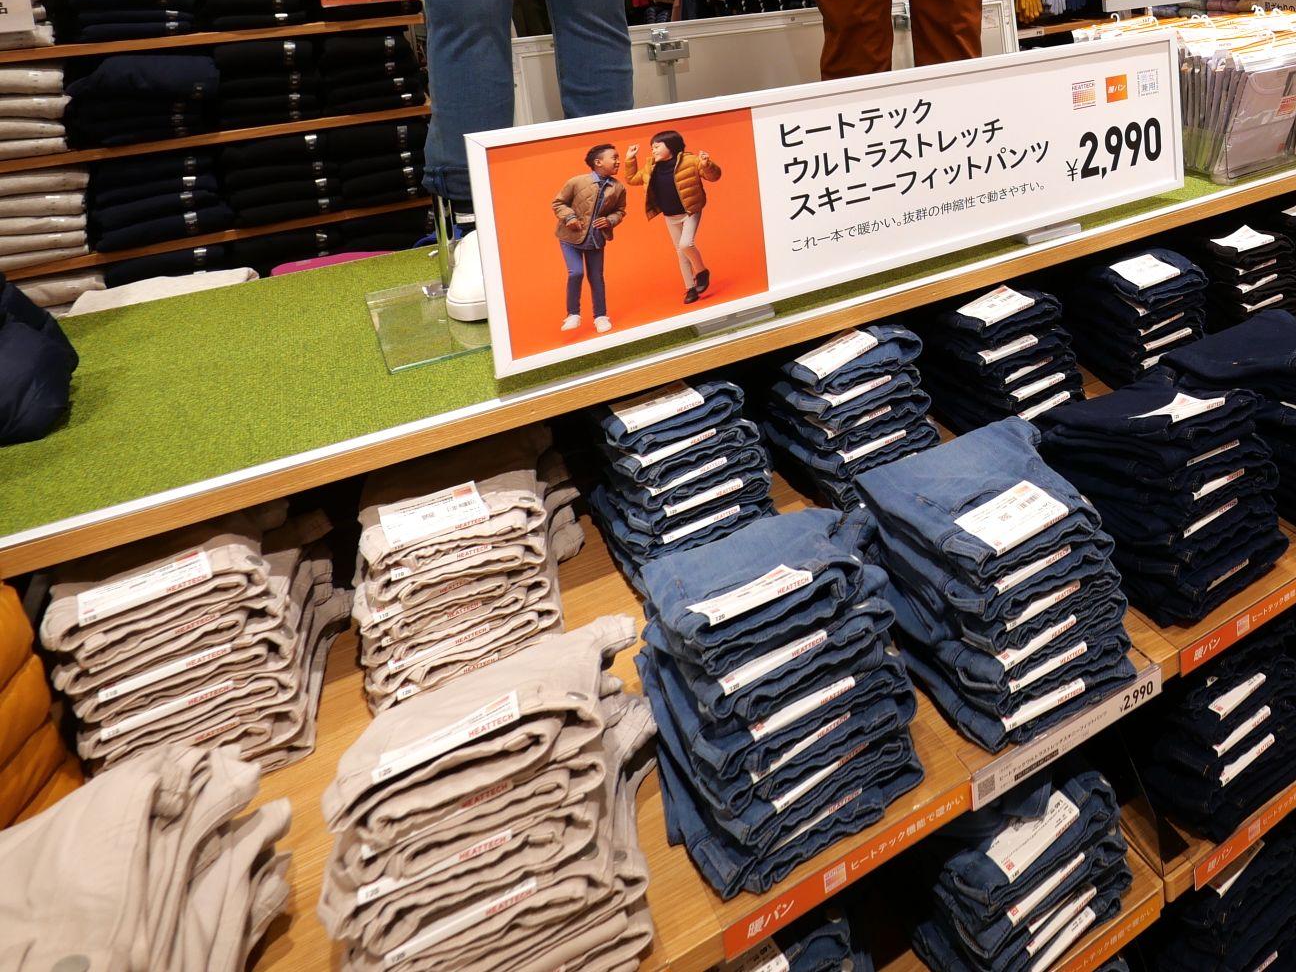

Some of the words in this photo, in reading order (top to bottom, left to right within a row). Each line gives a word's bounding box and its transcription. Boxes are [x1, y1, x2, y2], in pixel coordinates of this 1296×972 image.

[779, 98, 933, 149] ヒートテック
[783, 118, 1004, 185] ウルトラストレッチ
[1065, 117, 1162, 183] ¥2,990
[789, 140, 1050, 221] スキニーフィットパンツ
[791, 181, 1045, 252] これ一本で暖かい。抜群の伸縮性で動きやすい。
[856, 342, 876, 356] HEATTECH
[676, 400, 702, 413] HEATTECH
[699, 460, 725, 473] HEATTECH
[715, 483, 741, 497] HEATTECH
[454, 516, 487, 530] HEATTECH
[713, 508, 738, 521] HEATTECH
[456, 545, 489, 559] HEATTECH
[1045, 547, 1069, 565] HEATTECH
[166, 574, 207, 594] HEATTECH
[777, 577, 809, 595] HEATTECH
[1054, 584, 1079, 601] HEATTECH
[174, 613, 216, 635] HEATTECH
[715, 613, 725, 621] 120
[455, 627, 487, 645] HEATTECH
[1051, 621, 1075, 638] HEATTECH
[791, 636, 824, 657] HEATTECH
[1060, 647, 1085, 664] HEATTECH
[1193, 636, 1221, 663] 暖パン
[185, 648, 227, 668] HEATTECH
[463, 657, 497, 674] HEATTECH
[187, 684, 230, 705] HEATTECH
[729, 683, 740, 692] 120
[820, 684, 853, 705] HEATTECH
[1057, 687, 1083, 705] HEATTECH
[1119, 680, 1154, 714] ¥2,990
[468, 712, 514, 738] HEATTECH
[817, 714, 848, 739] HEATTECH
[461, 782, 508, 809] HEATTECH
[458, 835, 508, 862] HEATTECH
[747, 899, 795, 939] 暖パン
[851, 794, 965, 871] ヒートテック機能で暖かい
[485, 888, 534, 917] HEATTECH
[1071, 907, 1155, 972] ートテック機能で暖かい
